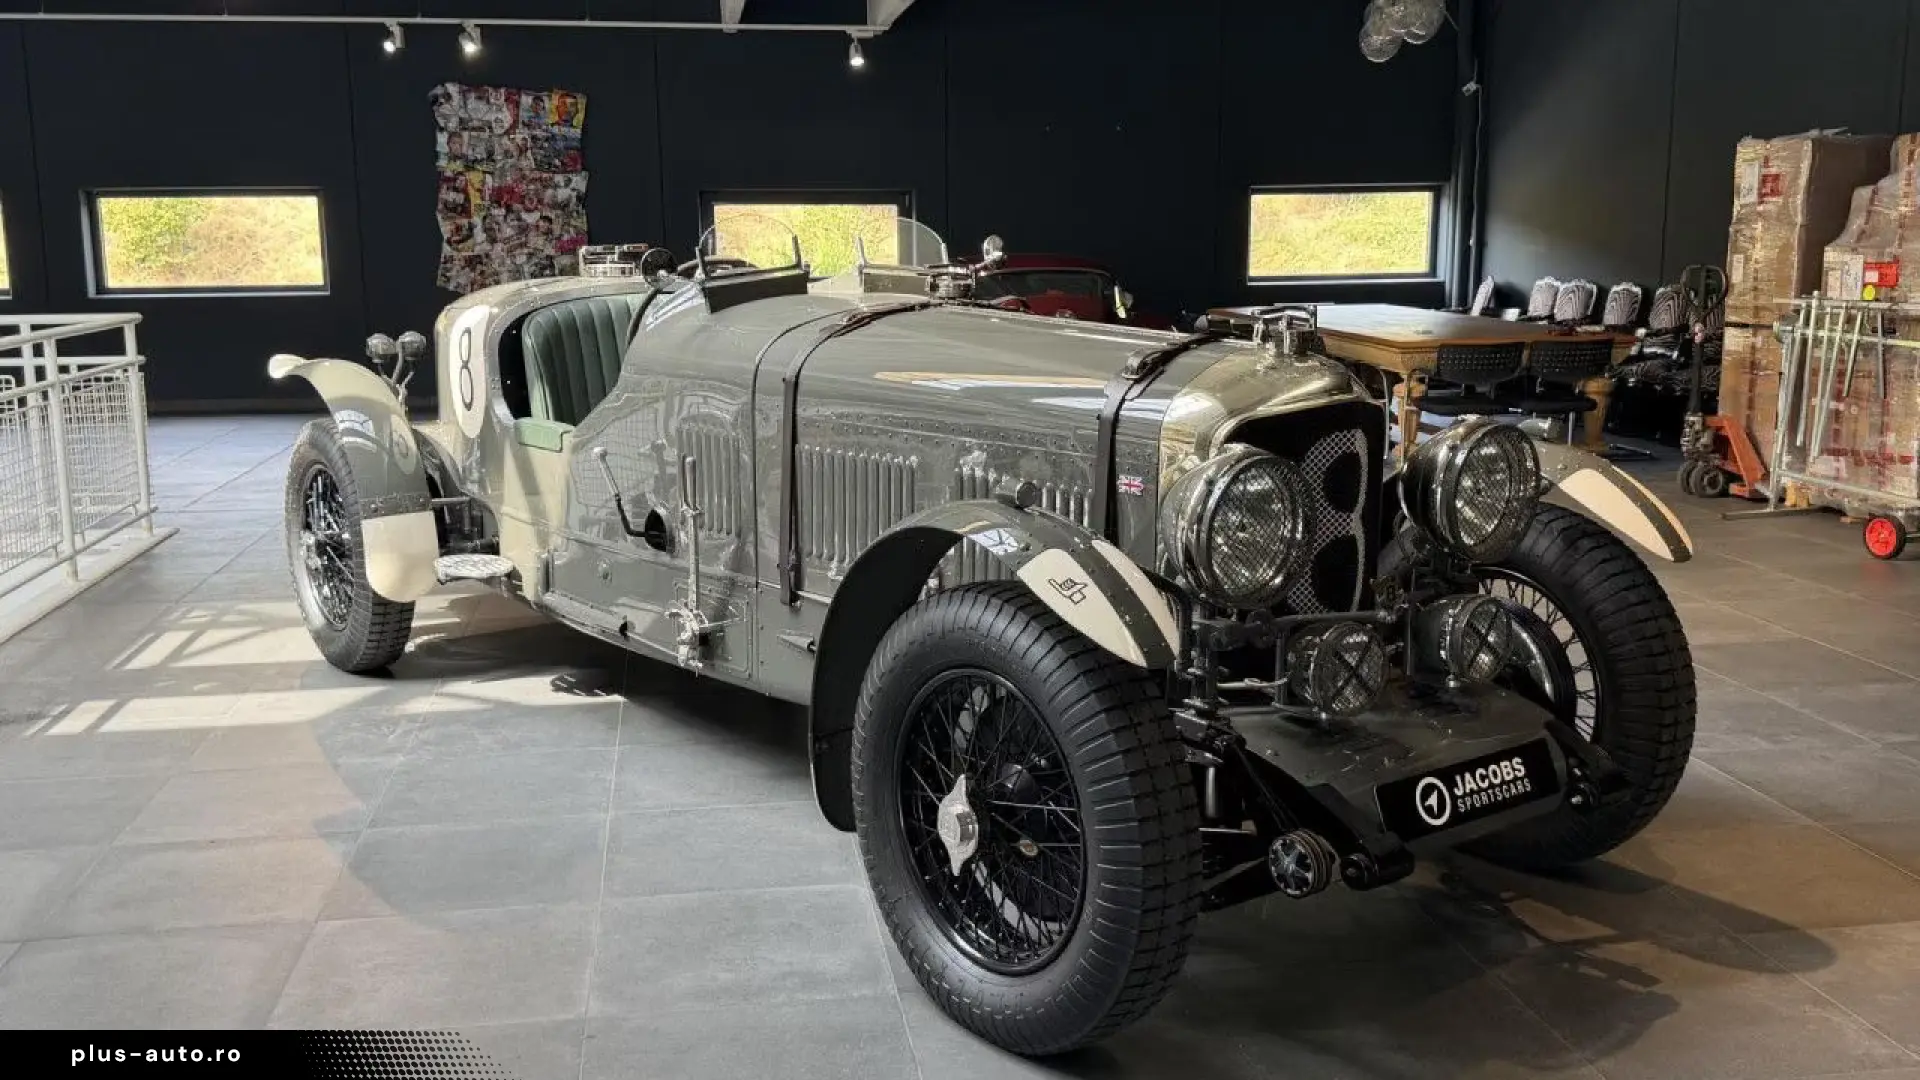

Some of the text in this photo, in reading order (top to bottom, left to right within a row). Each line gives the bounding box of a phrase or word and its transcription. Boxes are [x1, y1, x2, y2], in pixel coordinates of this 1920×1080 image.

[459, 327, 474, 411] 8
[1453, 756, 1525, 796] JACOBS
[1457, 778, 1531, 813] SPORTSCARS
